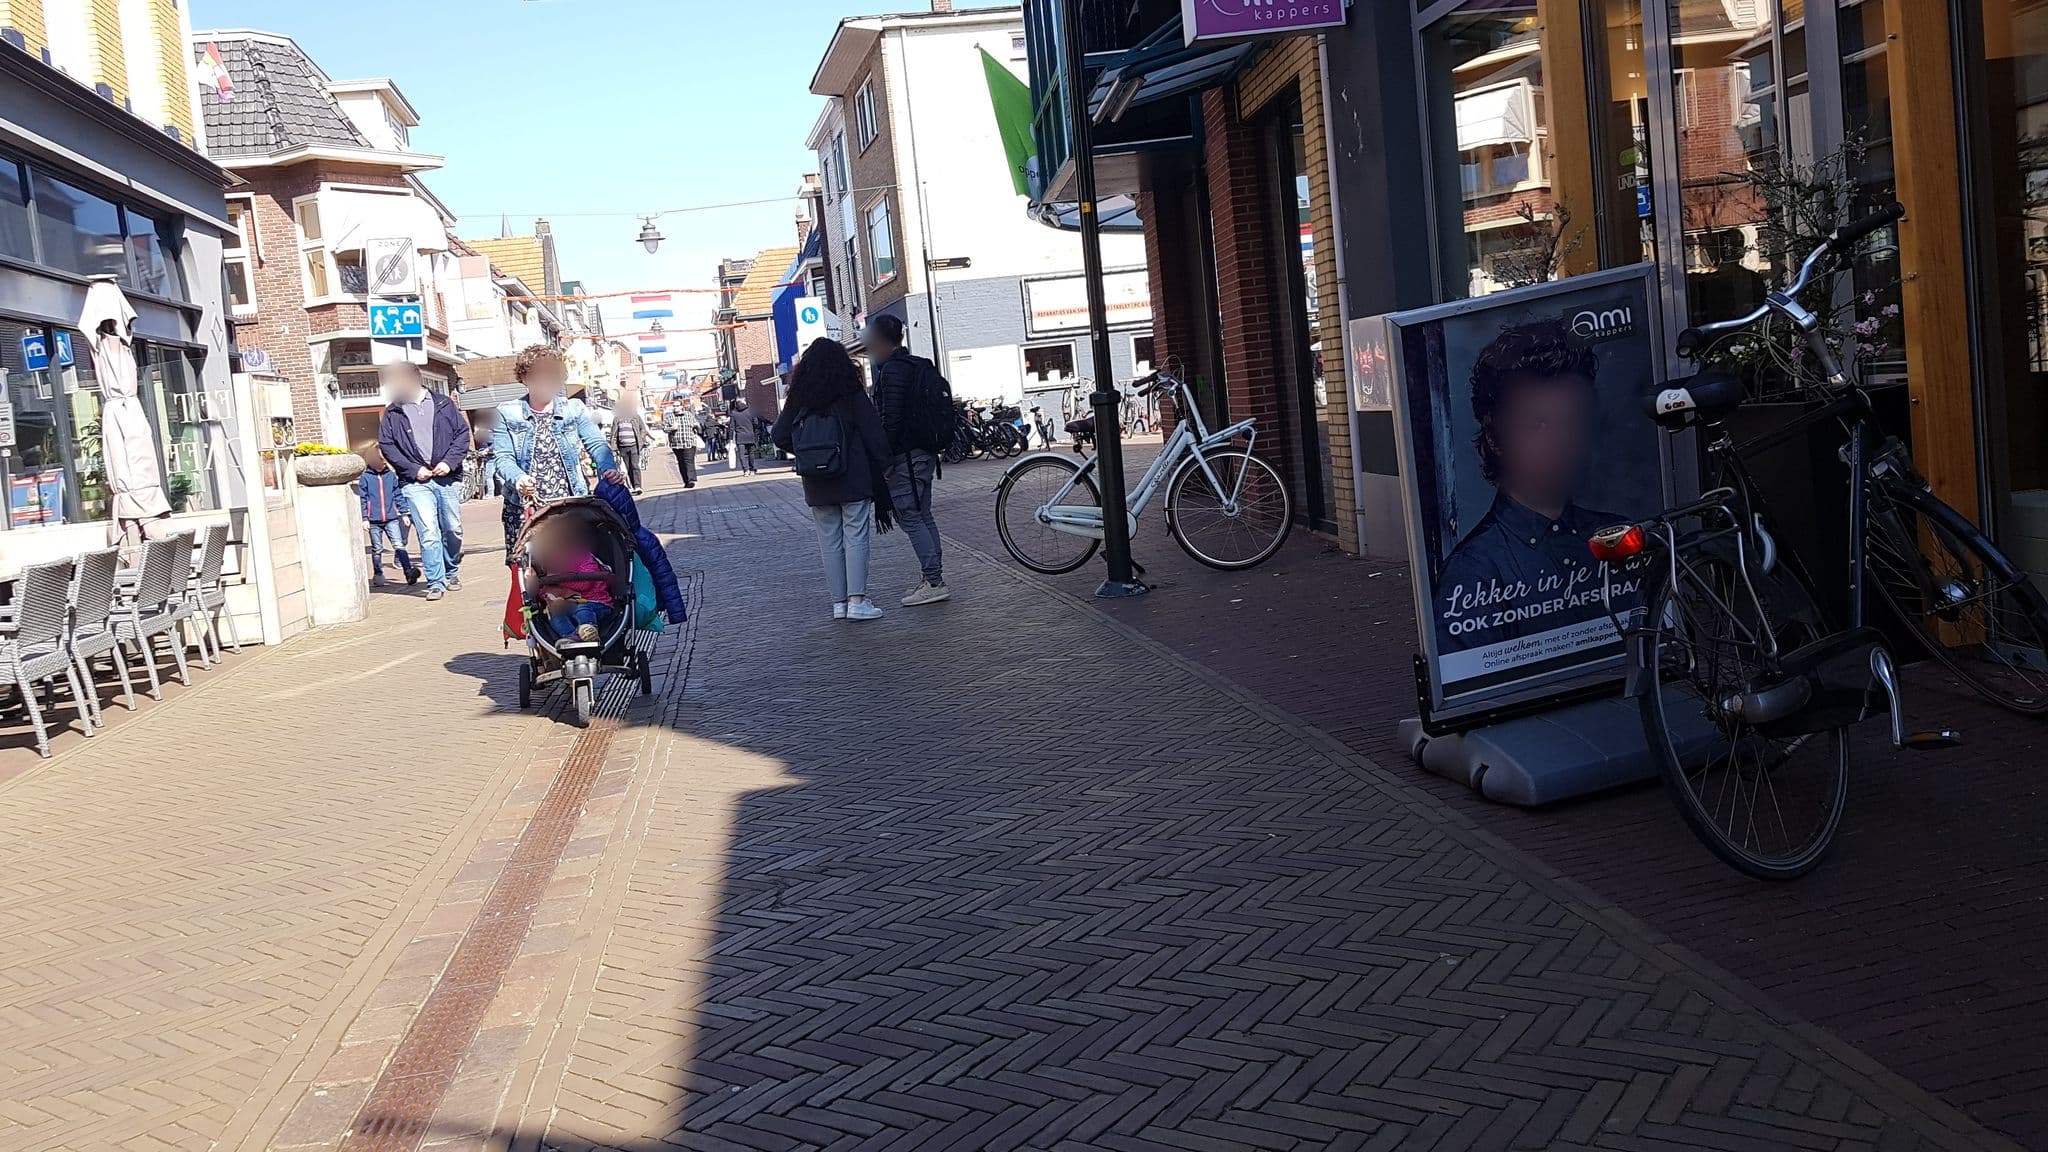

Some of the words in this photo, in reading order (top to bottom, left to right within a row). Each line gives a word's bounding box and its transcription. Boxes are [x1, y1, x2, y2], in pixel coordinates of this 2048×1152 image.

[1254, 4, 1330, 21] kappers
[378, 240, 401, 248] ZONE
[1595, 325, 1632, 338] kappers
[1443, 578, 1532, 618] Lekker
[1538, 569, 1563, 592] in
[1563, 560, 1592, 600] je
[1449, 615, 1489, 636] OOK
[1492, 598, 1564, 627] ZONDER
[1482, 649, 1503, 659] Altijd
[1544, 634, 1561, 644] met
[1561, 631, 1570, 640] of
[1571, 627, 1598, 638] zonder
[1484, 658, 1510, 668] Online
[1511, 649, 1543, 662] afspraak
[1544, 641, 1574, 654] maken?
